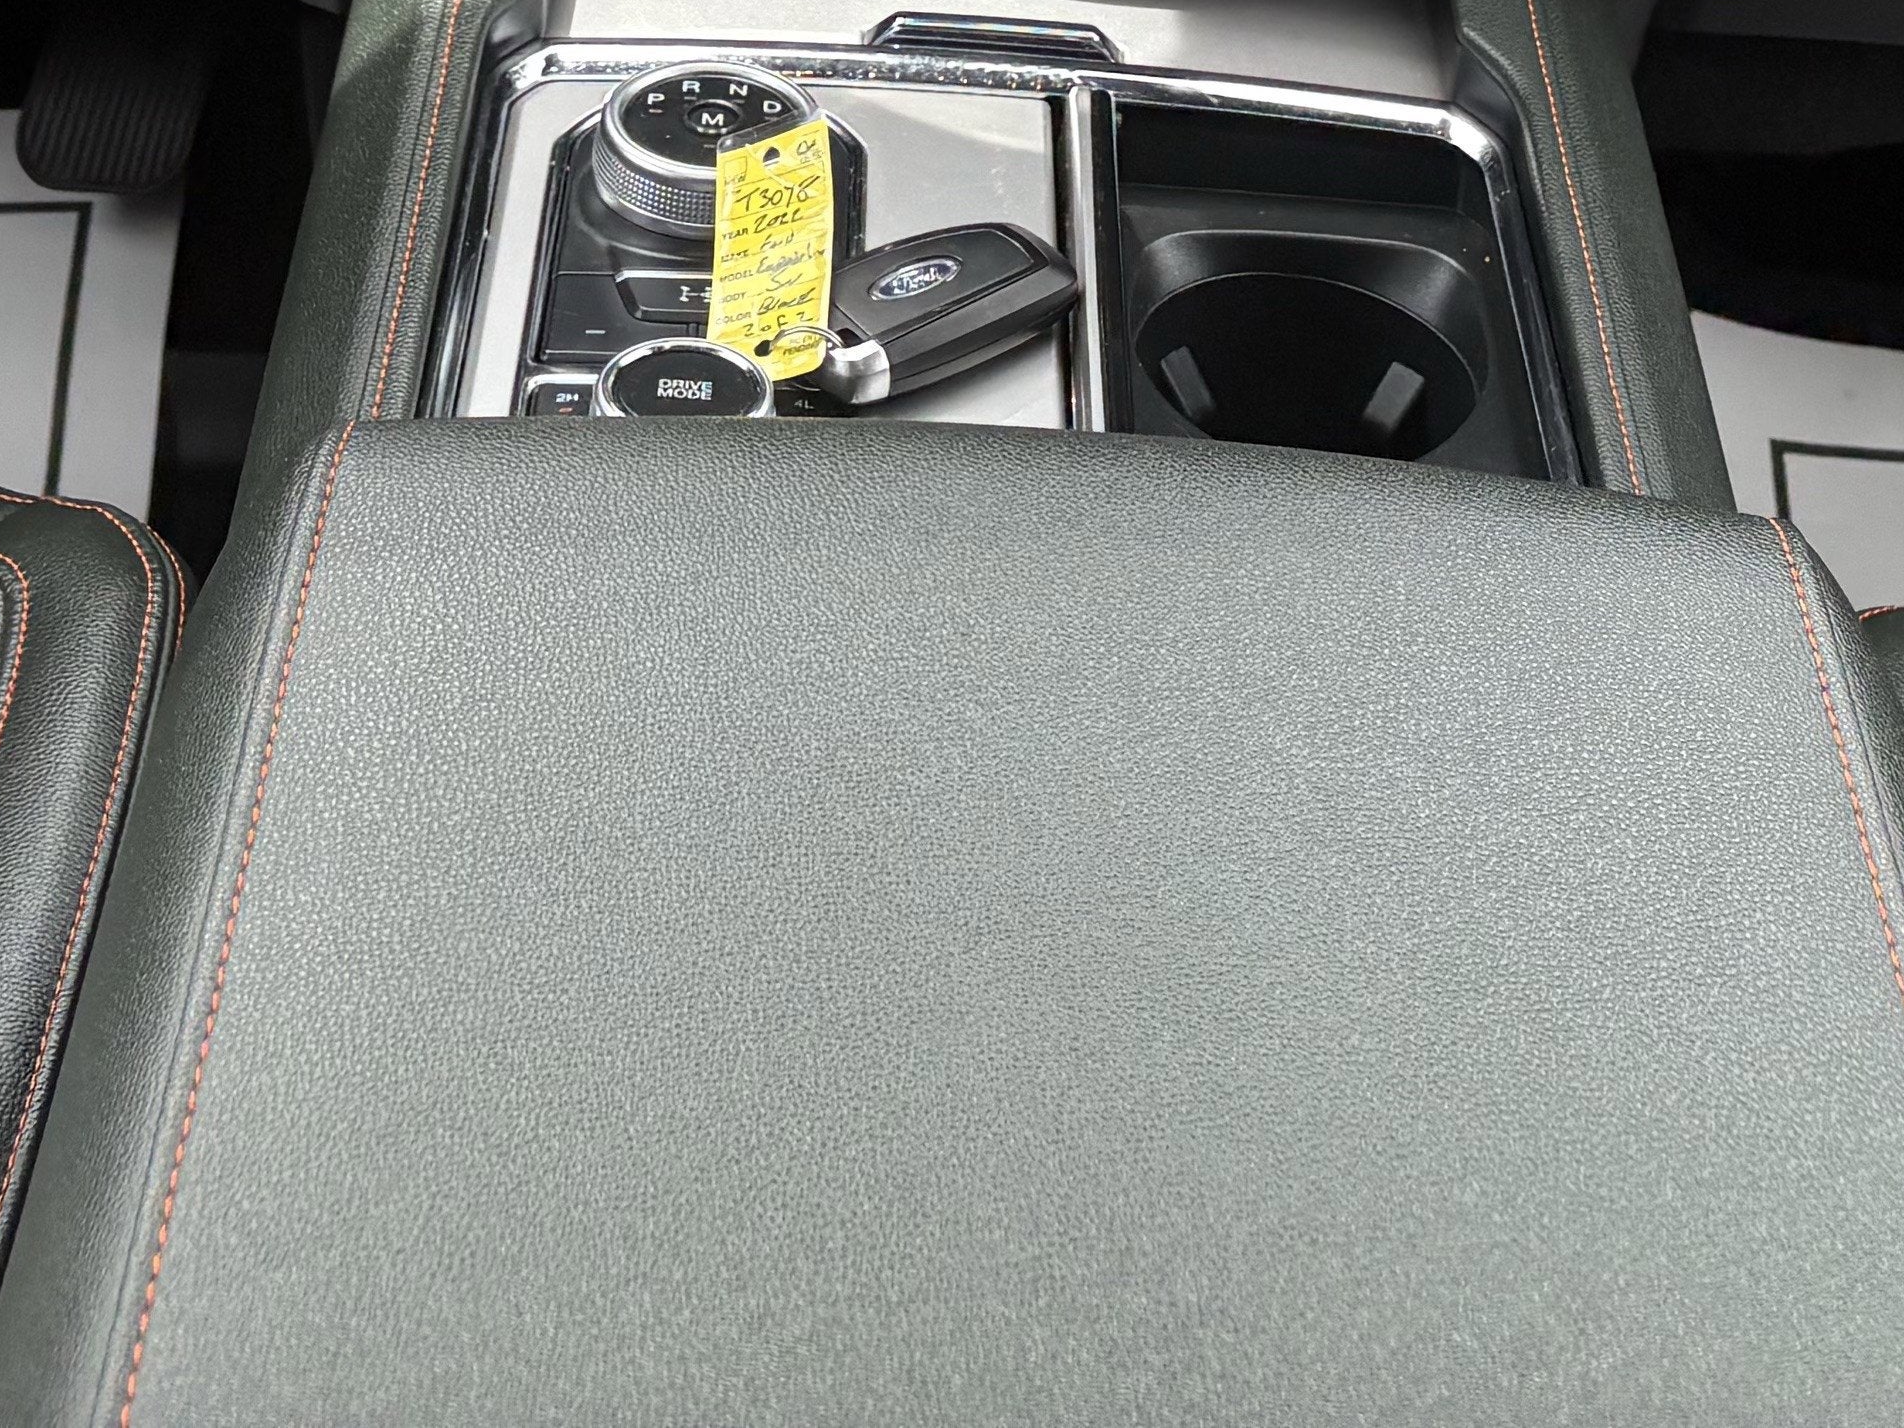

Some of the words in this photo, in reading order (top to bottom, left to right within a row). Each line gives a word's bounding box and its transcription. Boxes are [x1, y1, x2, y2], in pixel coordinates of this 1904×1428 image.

[682, 80, 701, 93] R
[729, 83, 748, 96] N
[647, 92, 665, 106] P
[763, 99, 782, 113] D
[701, 111, 725, 127] M
[657, 377, 714, 391] DRIVE
[656, 386, 713, 402] MODE
